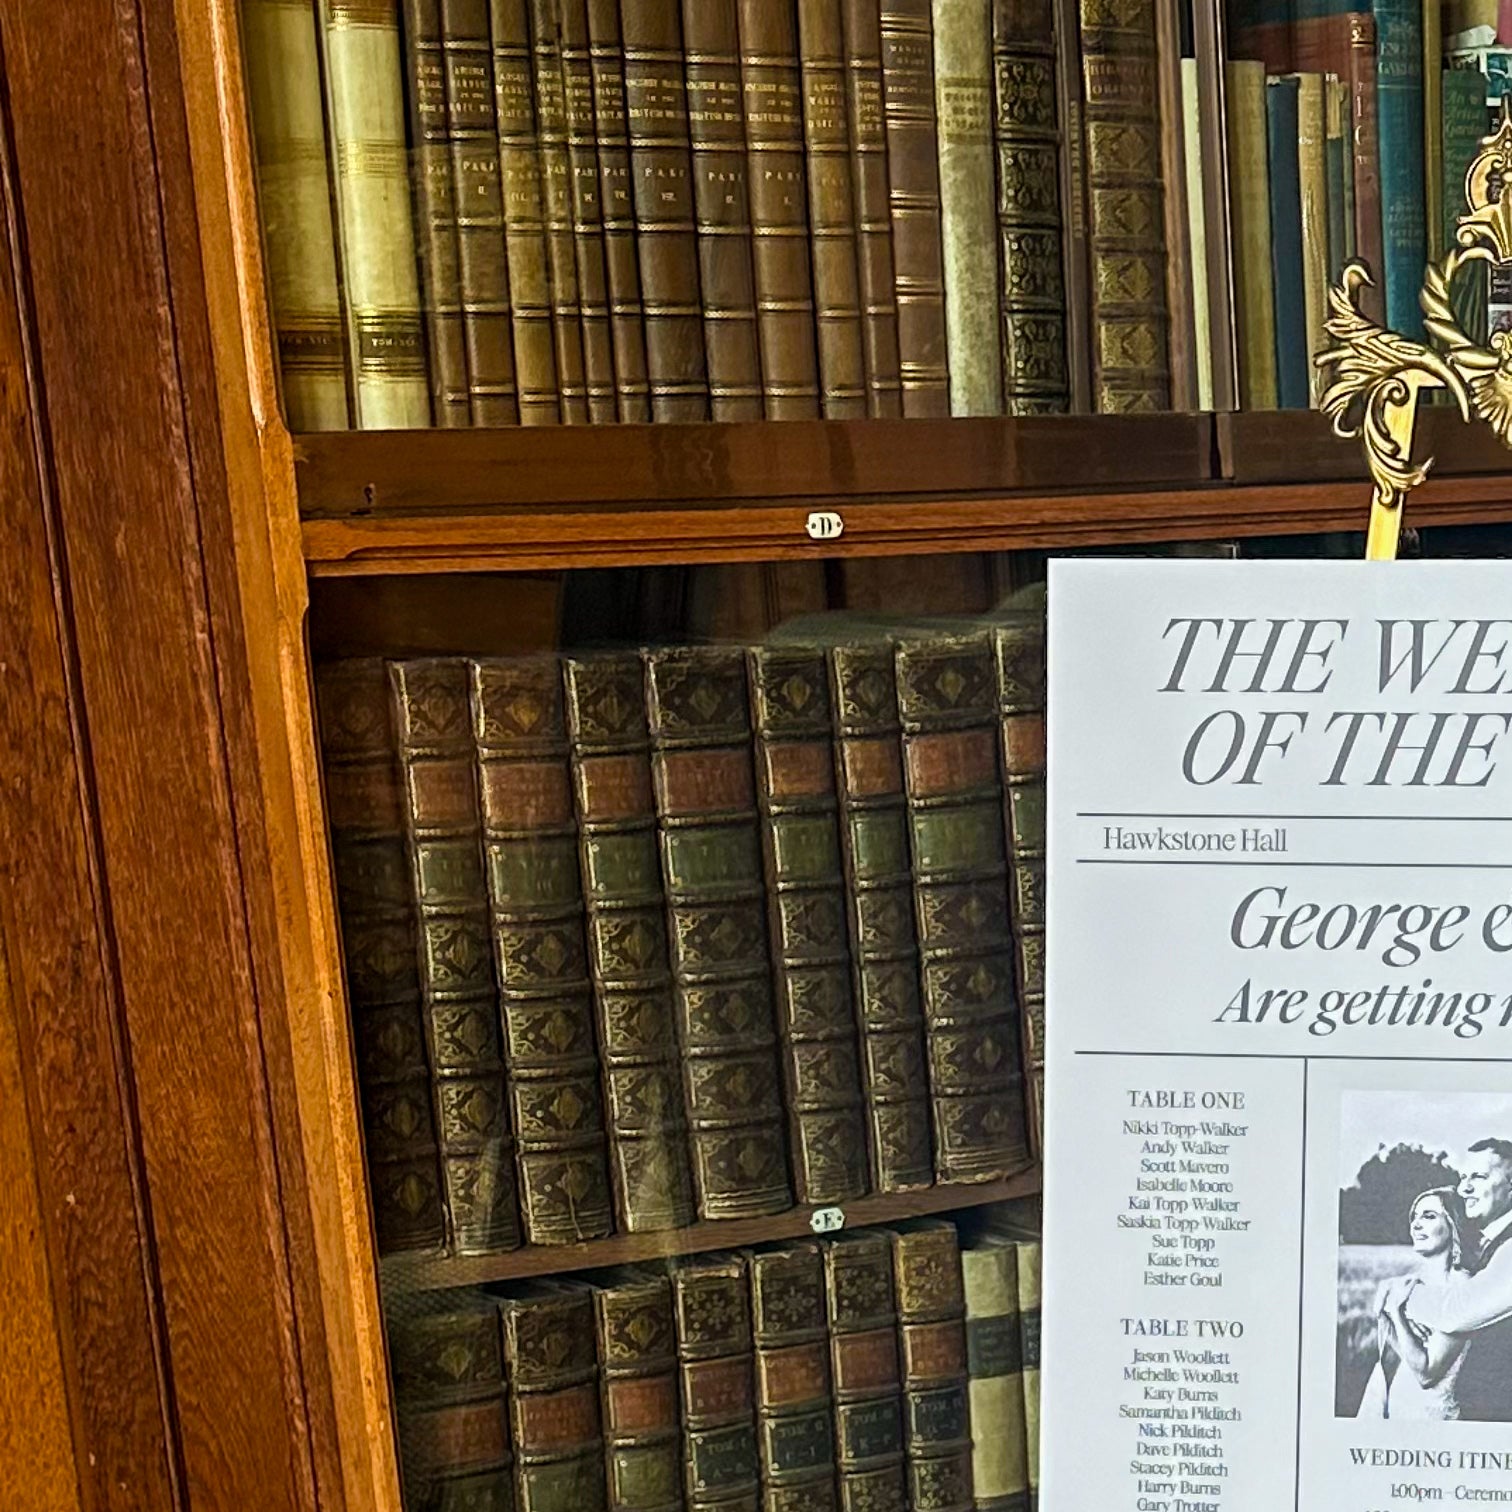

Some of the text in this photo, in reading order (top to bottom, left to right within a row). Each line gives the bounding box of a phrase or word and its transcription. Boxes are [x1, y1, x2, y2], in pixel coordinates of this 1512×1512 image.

[819, 517, 832, 536] D
[1156, 618, 1349, 693] THE
[1182, 710, 1309, 785] OF
[1318, 712, 1512, 787] THE
[1103, 827, 1288, 852] Hawkstone Hall
[1231, 886, 1470, 967] George
[1213, 980, 1307, 1026] Are
[1312, 978, 1501, 1039] getting
[1127, 1090, 1245, 1110] TABLE ONE
[1123, 1120, 1158, 1135] Nikki
[1140, 1140, 1230, 1157] Andy Walker
[1141, 1158, 1177, 1173] Scott
[1136, 1177, 1233, 1193] Isabelle Moore
[1128, 1196, 1150, 1210] Kai
[1192, 1198, 1240, 1212] Walker
[1152, 1234, 1178, 1248] Sue
[1147, 1252, 1219, 1268] Katie Price
[1144, 1271, 1188, 1286] Esther
[1120, 1318, 1243, 1338] TABLE TWO
[1130, 1348, 1170, 1364] Jason
[1124, 1367, 1180, 1382] Michelle
[1144, 1386, 1218, 1403] Katy Burns
[1119, 1404, 1188, 1419] Samantha
[1138, 1423, 1169, 1438] Nick
[1137, 1441, 1171, 1456] Dave
[1350, 1448, 1452, 1468] WEDDING
[1130, 1460, 1175, 1478] Stacey
[1138, 1479, 1221, 1496] Harry Burns
